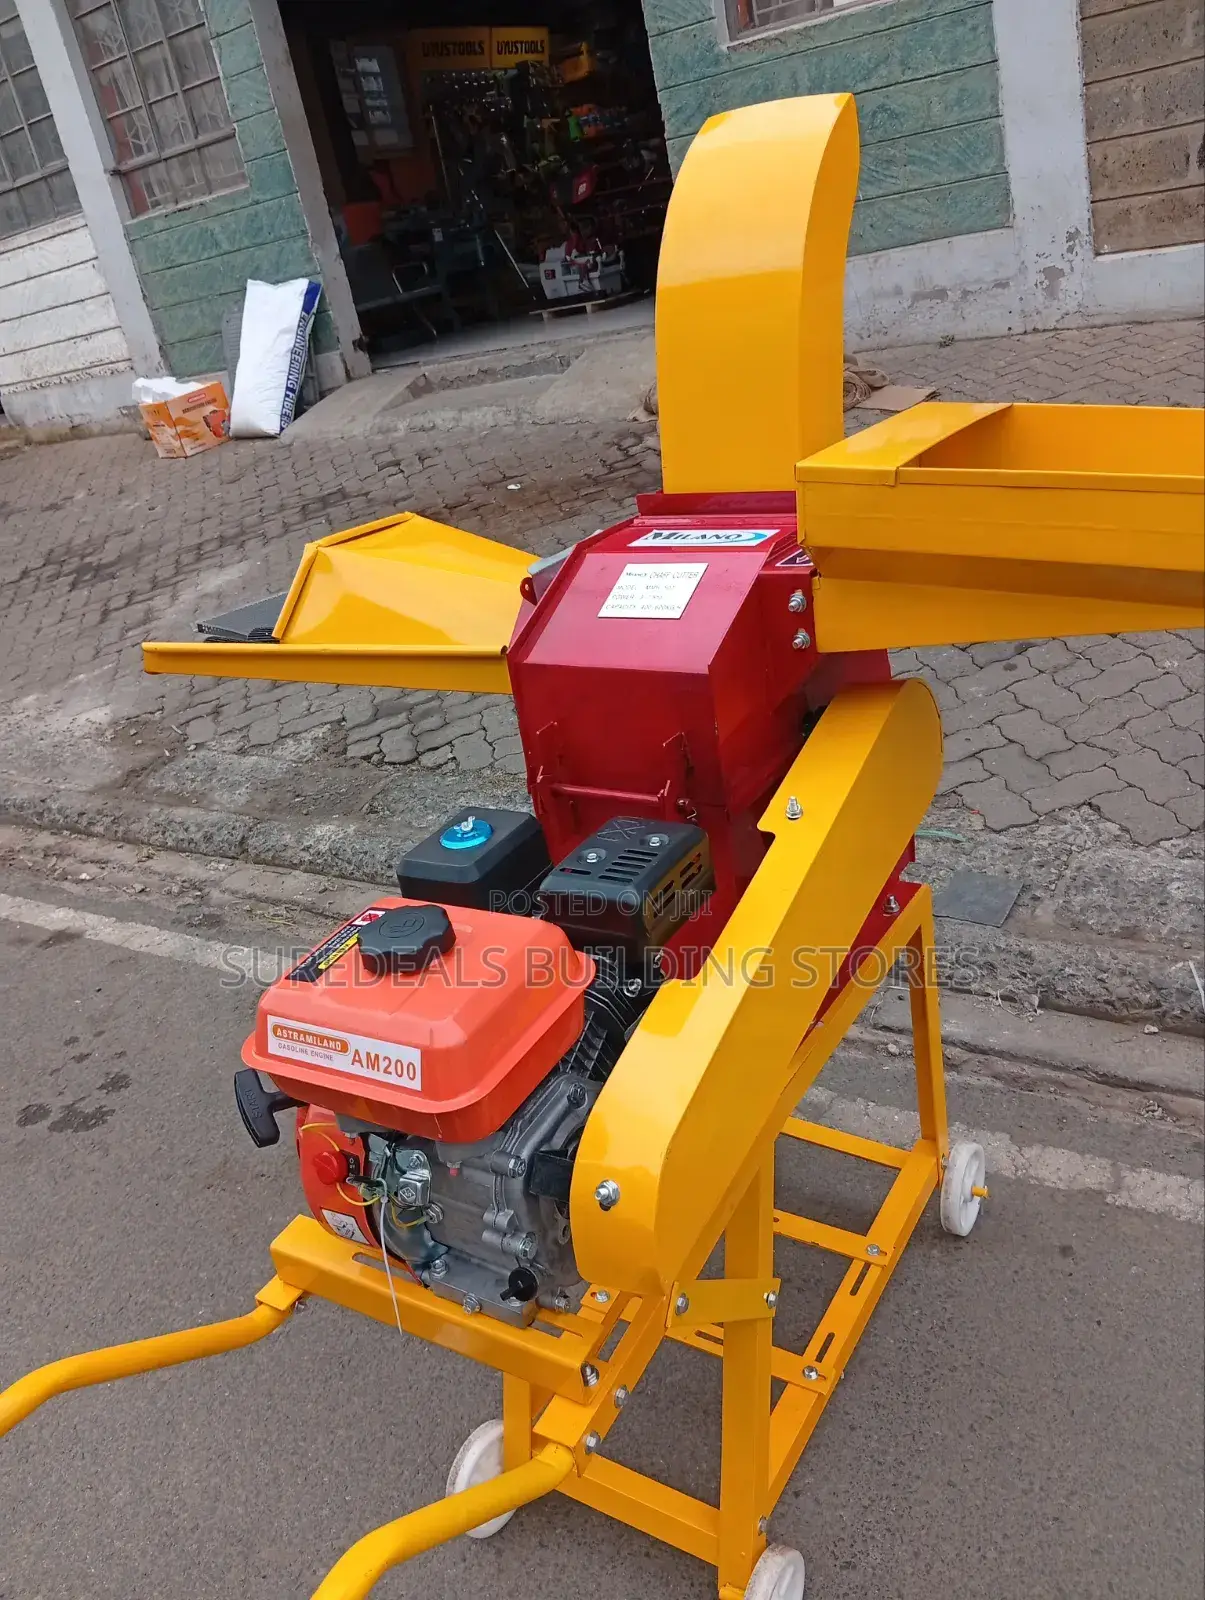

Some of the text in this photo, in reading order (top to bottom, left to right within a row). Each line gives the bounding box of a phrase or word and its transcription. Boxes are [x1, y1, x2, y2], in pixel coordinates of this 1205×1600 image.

[287, 312, 309, 390] ENGINEERING
[277, 1042, 334, 1062] GASOLINE ENGINE
[351, 1048, 417, 1081] AM200
